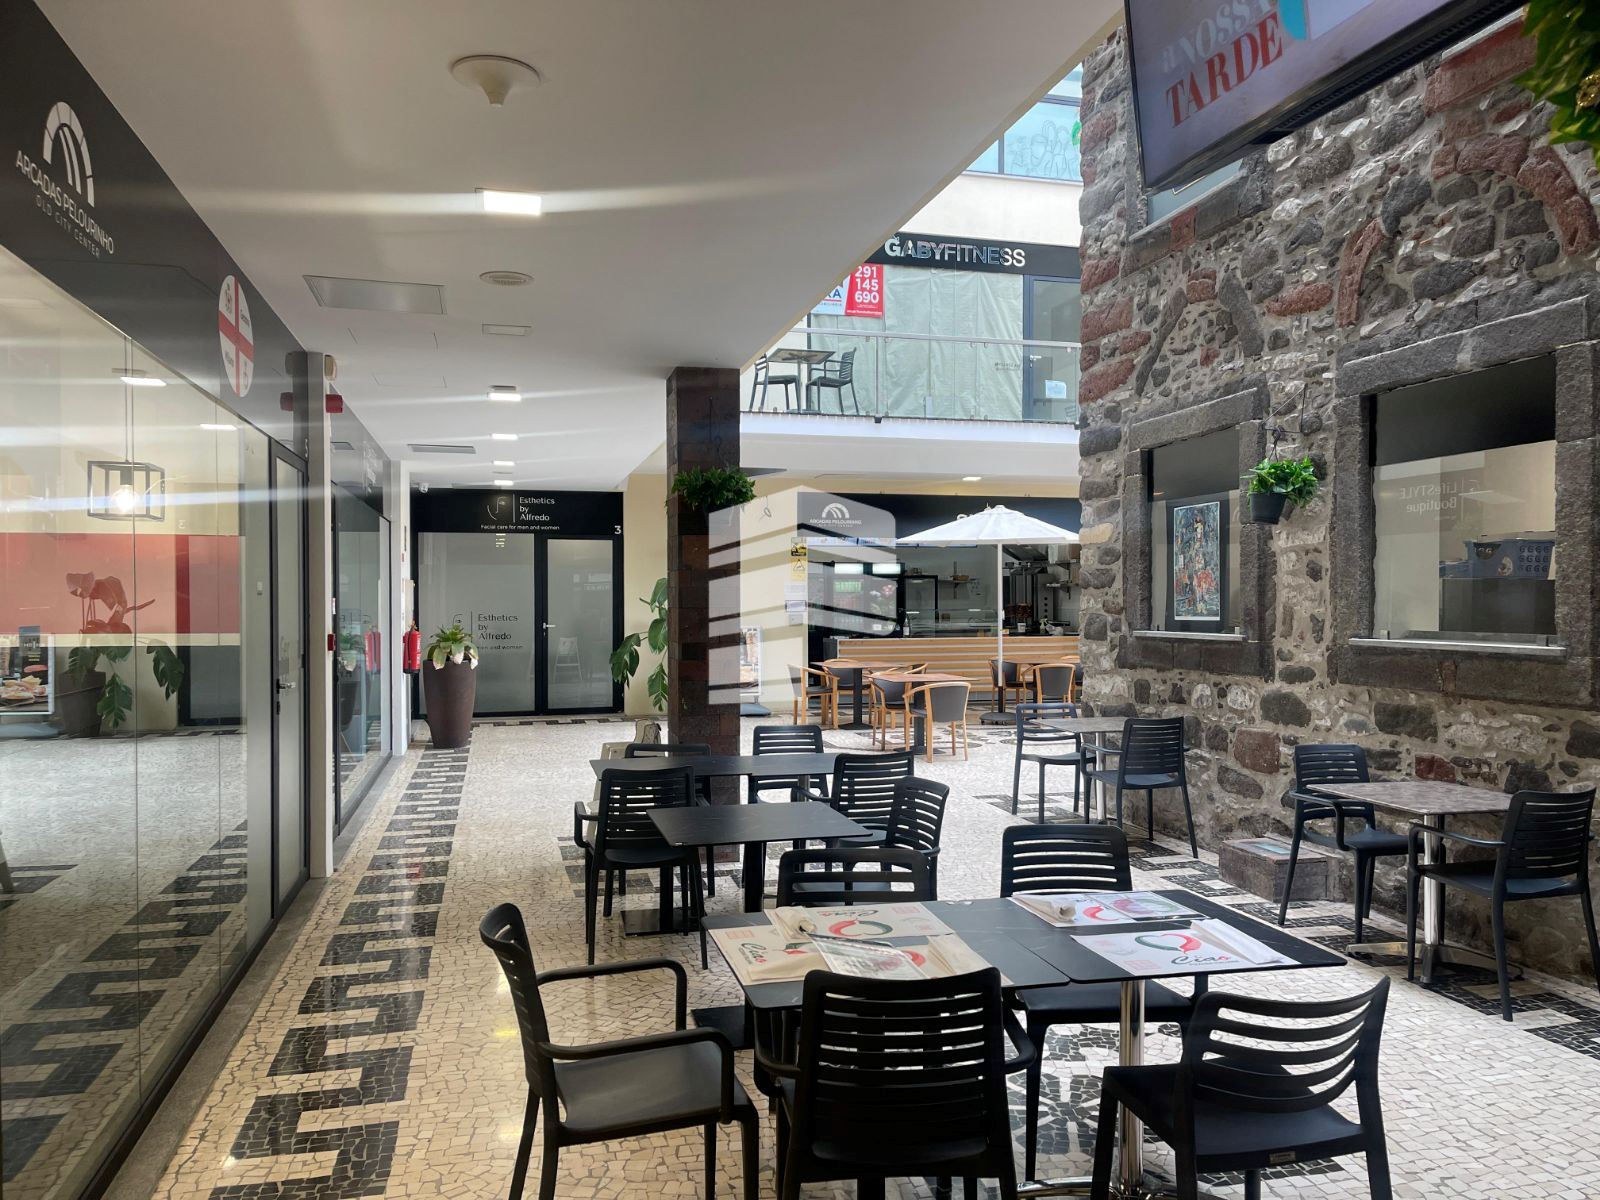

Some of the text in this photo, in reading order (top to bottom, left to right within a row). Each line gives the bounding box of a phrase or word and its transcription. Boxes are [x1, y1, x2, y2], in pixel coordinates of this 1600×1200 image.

[1166, 12, 1283, 128] TARDE
[16, 150, 114, 255] ARCADAS PELOURINHO
[36, 194, 101, 259] OLD CITY CENTER
[884, 237, 1026, 267] GABYFITNESS
[855, 265, 877, 278] 291
[856, 278, 879, 291] 145
[854, 290, 880, 303] 690
[519, 496, 555, 504] Esthetics
[519, 513, 550, 521] Alfredo
[614, 525, 622, 534] 3
[478, 613, 518, 622] Esthetics
[478, 624, 489, 633] by
[479, 632, 512, 640] Alfredo
[1171, 955, 1231, 965] Ciao
